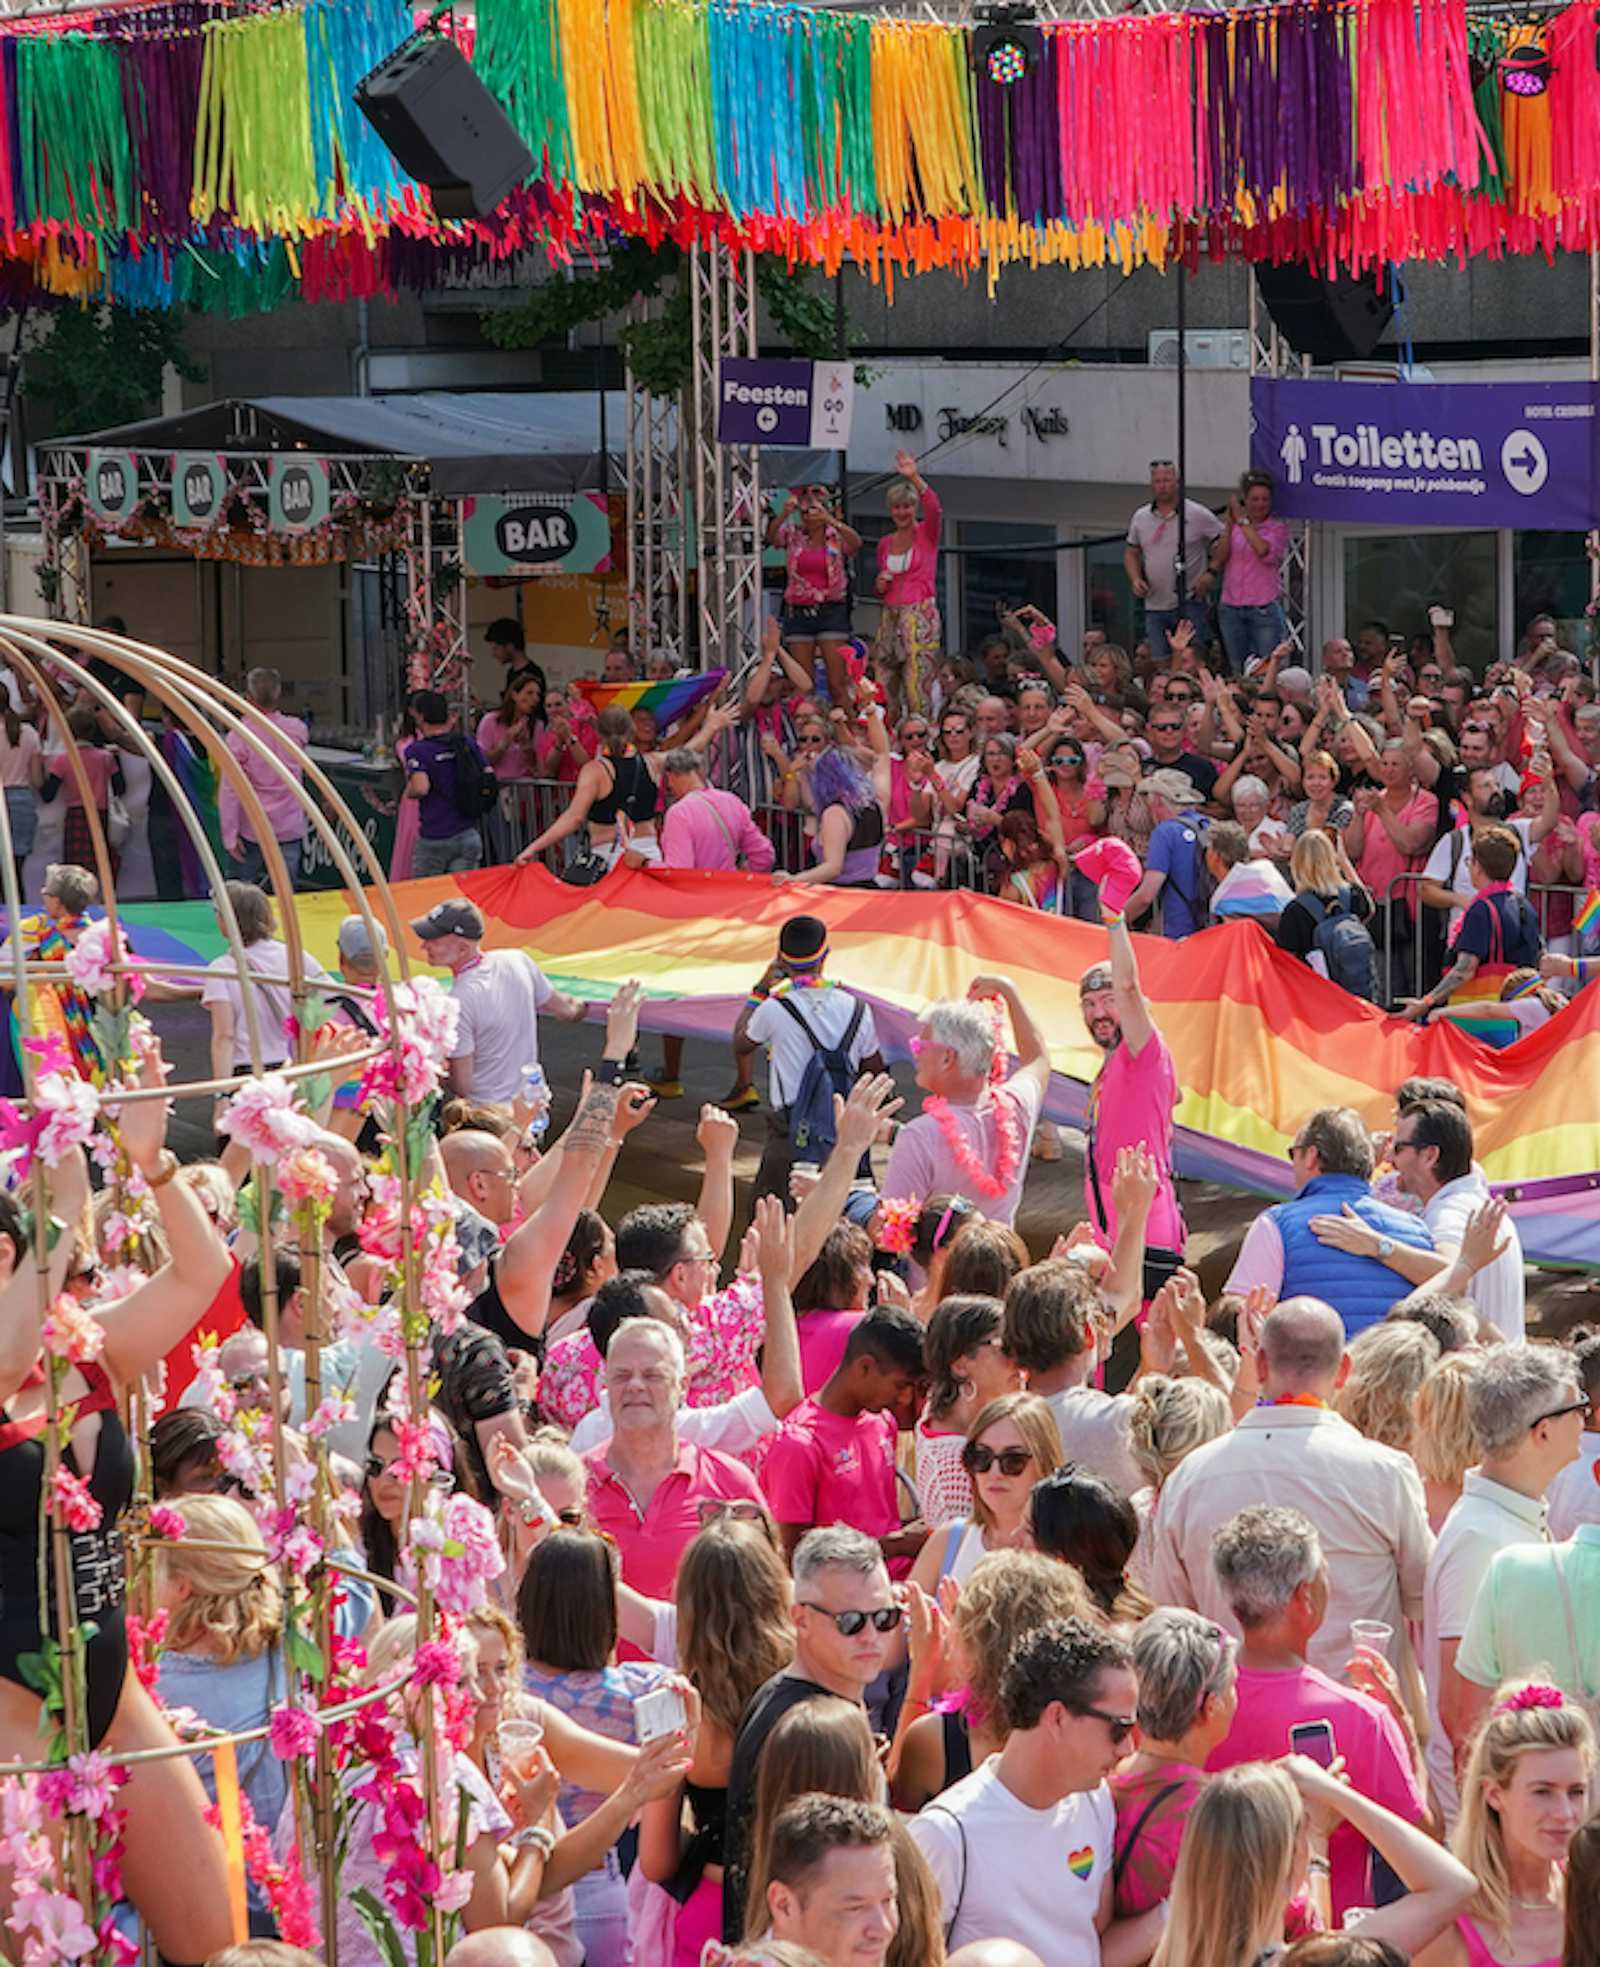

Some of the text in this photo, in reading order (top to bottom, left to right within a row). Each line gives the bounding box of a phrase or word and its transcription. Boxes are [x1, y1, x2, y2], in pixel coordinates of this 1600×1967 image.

[724, 381, 809, 407] Feesten
[885, 402, 923, 432] MD
[1020, 406, 1069, 443] Nails
[1311, 424, 1482, 471] Toiletten
[100, 471, 125, 501] BAR
[186, 474, 213, 506] BAR
[282, 478, 310, 511] BAR
[1312, 473, 1347, 487] Gratis
[1348, 475, 1393, 492] toegang
[504, 516, 570, 553] BAR
